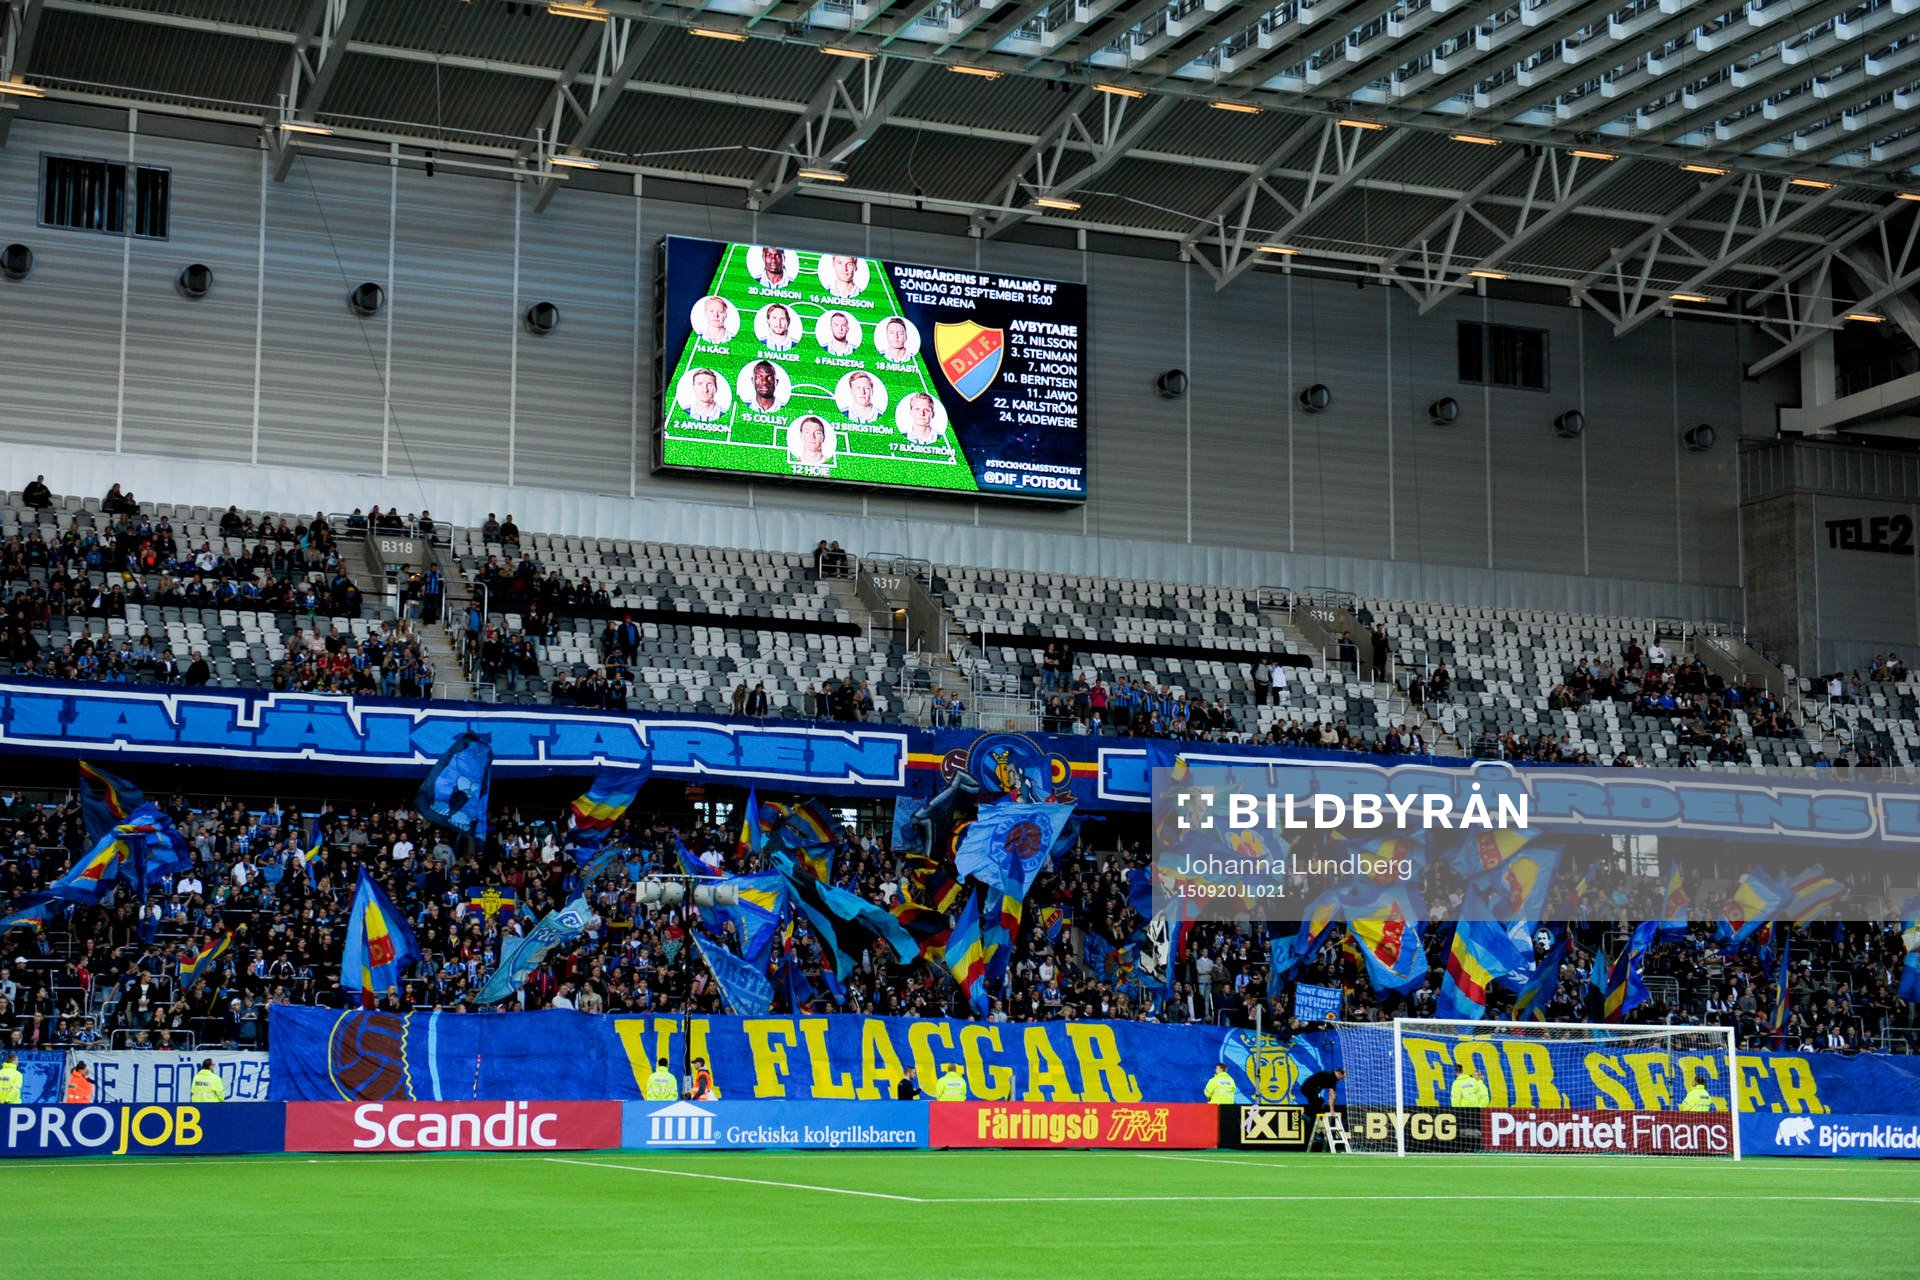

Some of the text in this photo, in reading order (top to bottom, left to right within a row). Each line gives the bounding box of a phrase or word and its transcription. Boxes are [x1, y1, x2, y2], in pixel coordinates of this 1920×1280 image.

[894, 266, 976, 285] DJURGÅRDENS
[979, 276, 990, 286] IF
[999, 279, 1041, 292] MALMÖ
[1043, 284, 1057, 293] FF
[760, 288, 802, 300] JOHNSON
[900, 279, 1052, 306] SÖNDAG 20 SEPTEMBER 15:00
[906, 293, 976, 309] TELE2 ARENA
[810, 294, 875, 309] 16 ANDERSSON
[1010, 320, 1077, 337] AVBYTARE
[1012, 334, 1077, 350] 23. NILSSON
[764, 351, 800, 362] WALKER
[1011, 347, 1077, 363] 3. STENMAN
[1028, 362, 1077, 376] 7. MOON
[1003, 373, 1077, 389] 10. BERNTSEN
[1027, 388, 1078, 402] 11. JAWO
[994, 398, 1078, 415] 22. KARLSTRÖM
[682, 422, 731, 433] ARVIDSSON
[754, 415, 788, 425] COLLEY
[999, 411, 1078, 428] 24. KADEWERE
[842, 424, 893, 435] BERGSTRÖM
[792, 466, 803, 474] 12
[984, 471, 1082, 491] @DIF_FOTBOLL
[1825, 514, 1914, 555] TELE2
[381, 541, 413, 554] B318
[0, 690, 902, 777] IALÄKTAREN
[614, 1018, 1831, 1114] VI FLAGGAR FÖR SEGER
[8, 1106, 203, 1154] PROJOB
[353, 1101, 557, 1147] Scandic
[977, 1108, 1169, 1142] Färingsö TRÄ
[1246, 1111, 1300, 1139] XL
[1491, 1112, 1728, 1151] Prioritet Finans
[727, 1126, 916, 1147] Grekiska kolgrillsbaren
